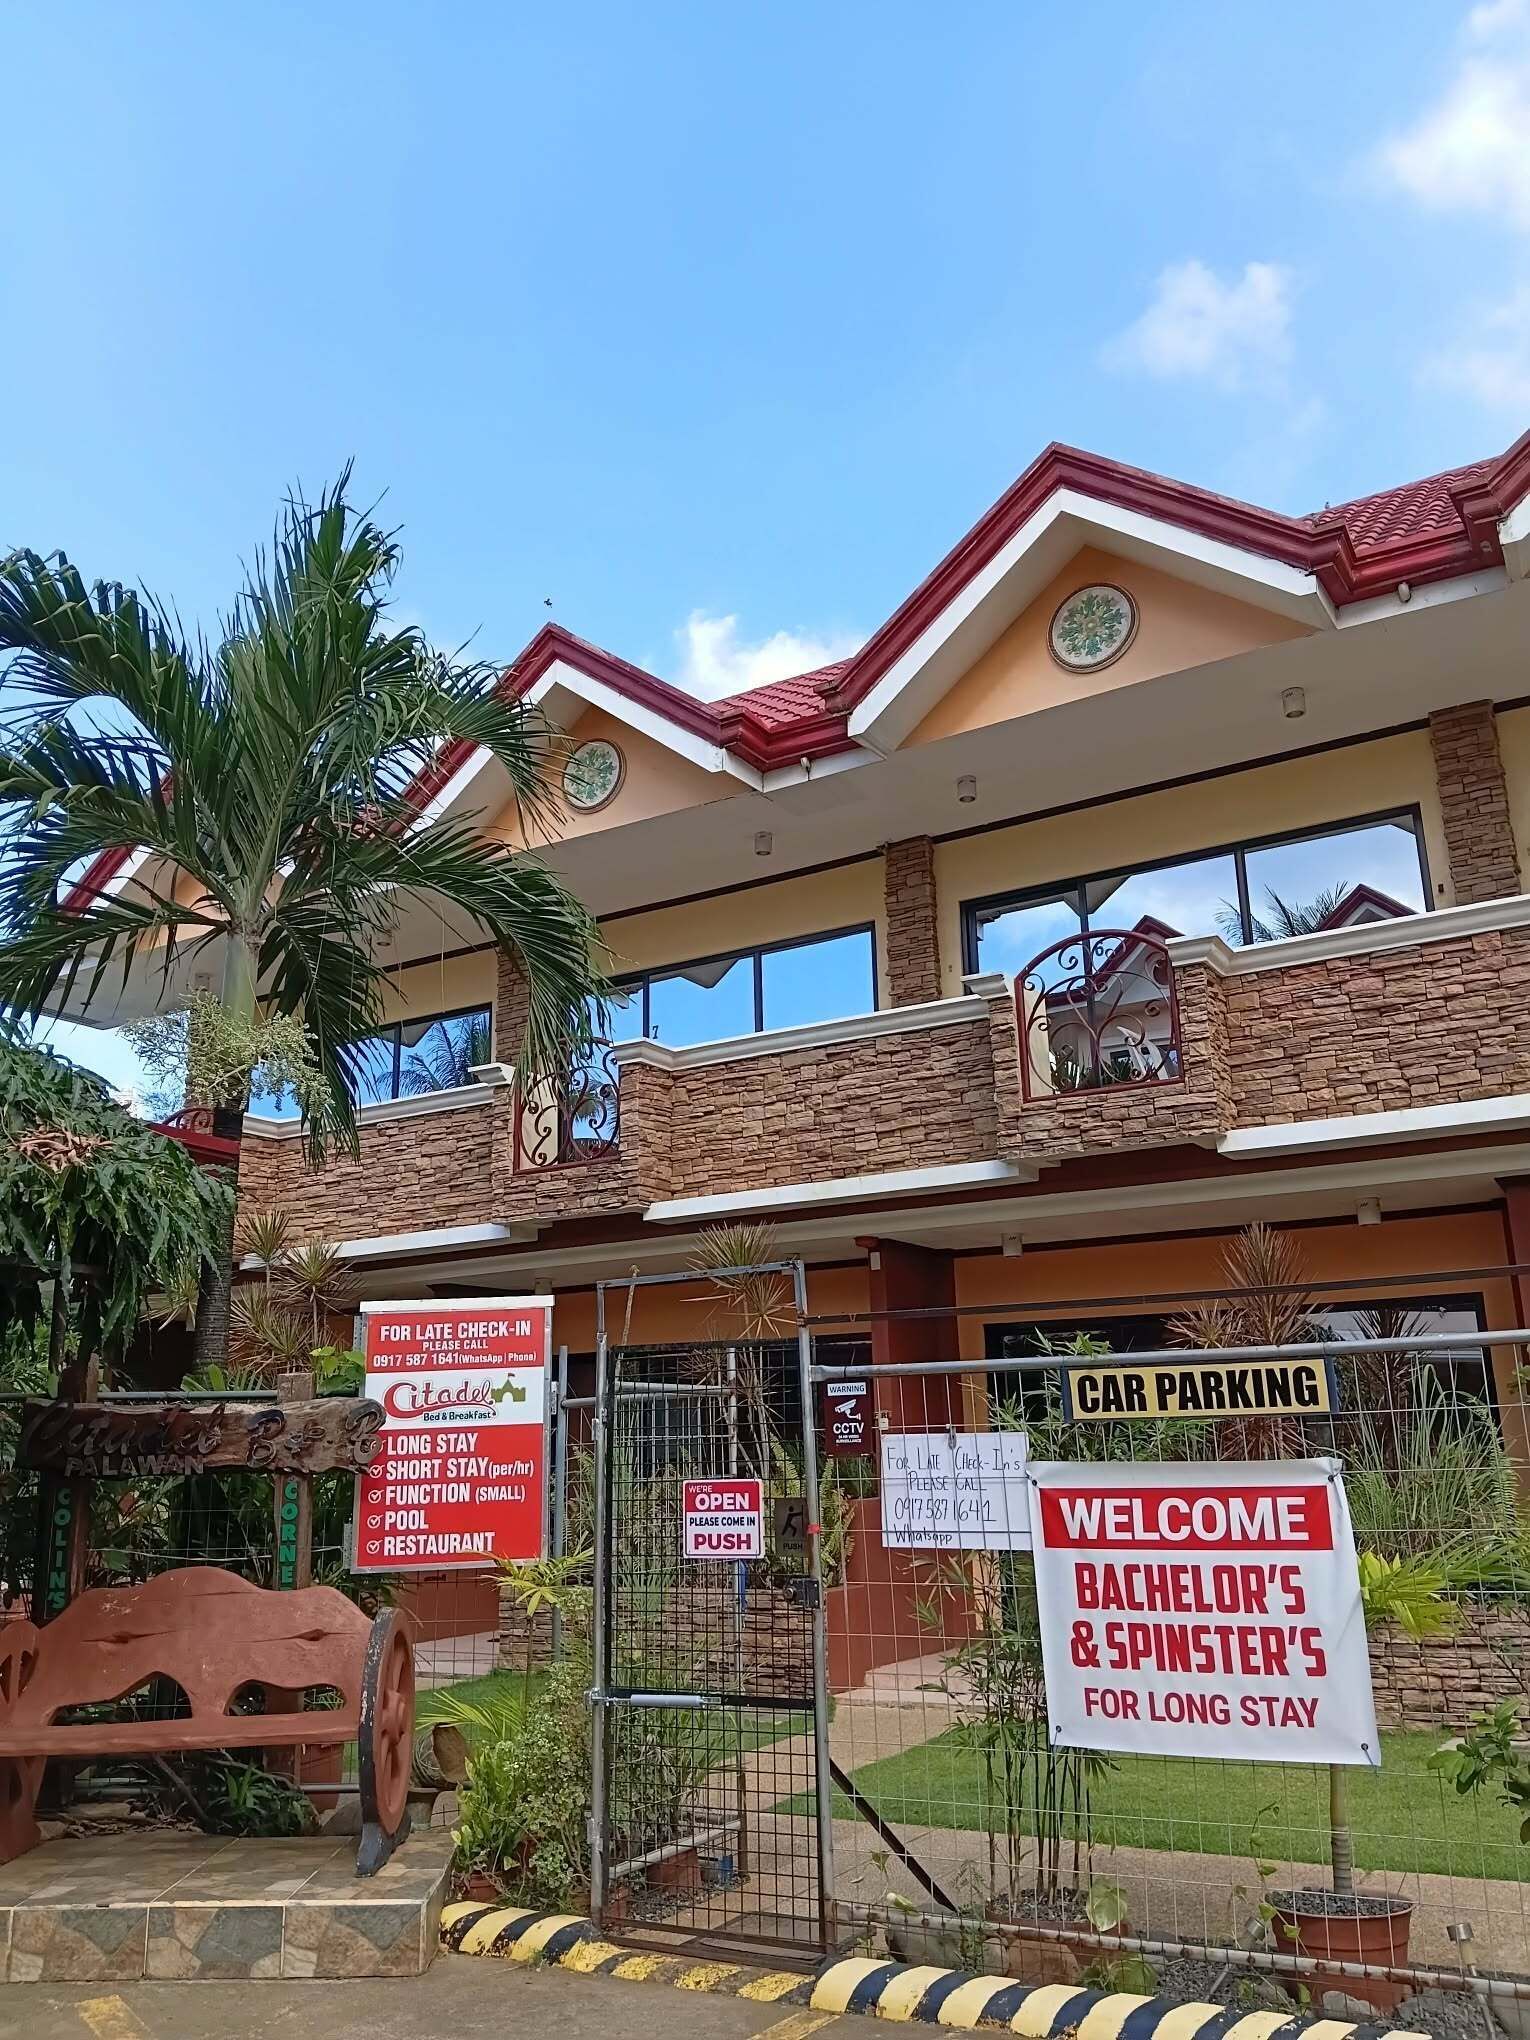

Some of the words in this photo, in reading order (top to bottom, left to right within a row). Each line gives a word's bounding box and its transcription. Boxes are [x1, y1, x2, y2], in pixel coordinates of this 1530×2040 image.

[380, 1325, 411, 1342] FOR
[415, 1323, 453, 1340] LATE
[457, 1320, 531, 1339] CHECK-IN
[422, 1340, 461, 1352] PLEASE
[464, 1339, 489, 1350] CALL
[373, 1355, 402, 1368] 0917
[405, 1354, 428, 1367] 587
[384, 1379, 496, 1420] Citadel
[829, 1384, 865, 1394] WARNING
[1076, 1372, 1147, 1415] CAR
[1155, 1365, 1321, 1412] PARKING
[423, 1412, 440, 1422] Bed
[441, 1412, 448, 1421] &
[449, 1410, 491, 1421] Breakfast
[833, 1422, 865, 1435] CCTV
[387, 1435, 431, 1456] LONG
[436, 1433, 478, 1454] STAY
[63, 1453, 204, 1477] PALAWAN
[386, 1459, 442, 1481] SHORT
[917, 1447, 941, 1471] LATE
[688, 1485, 713, 1493] WE'RE
[908, 1470, 949, 1491] PLEASE
[955, 1472, 987, 1491] CALL
[385, 1482, 471, 1506] FUNCTION
[475, 1485, 526, 1505] (SMALL)
[695, 1492, 750, 1511] OPEN
[384, 1510, 429, 1531] POOL
[689, 1517, 719, 1527] PLEASE
[721, 1516, 745, 1527] COME
[746, 1516, 756, 1527] IN
[1059, 1496, 1310, 1542] WELCOME
[279, 1481, 299, 1590] CORNE
[383, 1532, 496, 1557] RESTAURANT
[694, 1533, 752, 1550] PUSH
[1074, 1562, 1306, 1616] BACHELOR'S
[1070, 1620, 1101, 1668] &
[1105, 1622, 1327, 1677] SPINSTER'S
[1083, 1687, 1140, 1721] FOR
[1148, 1691, 1231, 1725] LONG
[1240, 1697, 1320, 1729] STAY
